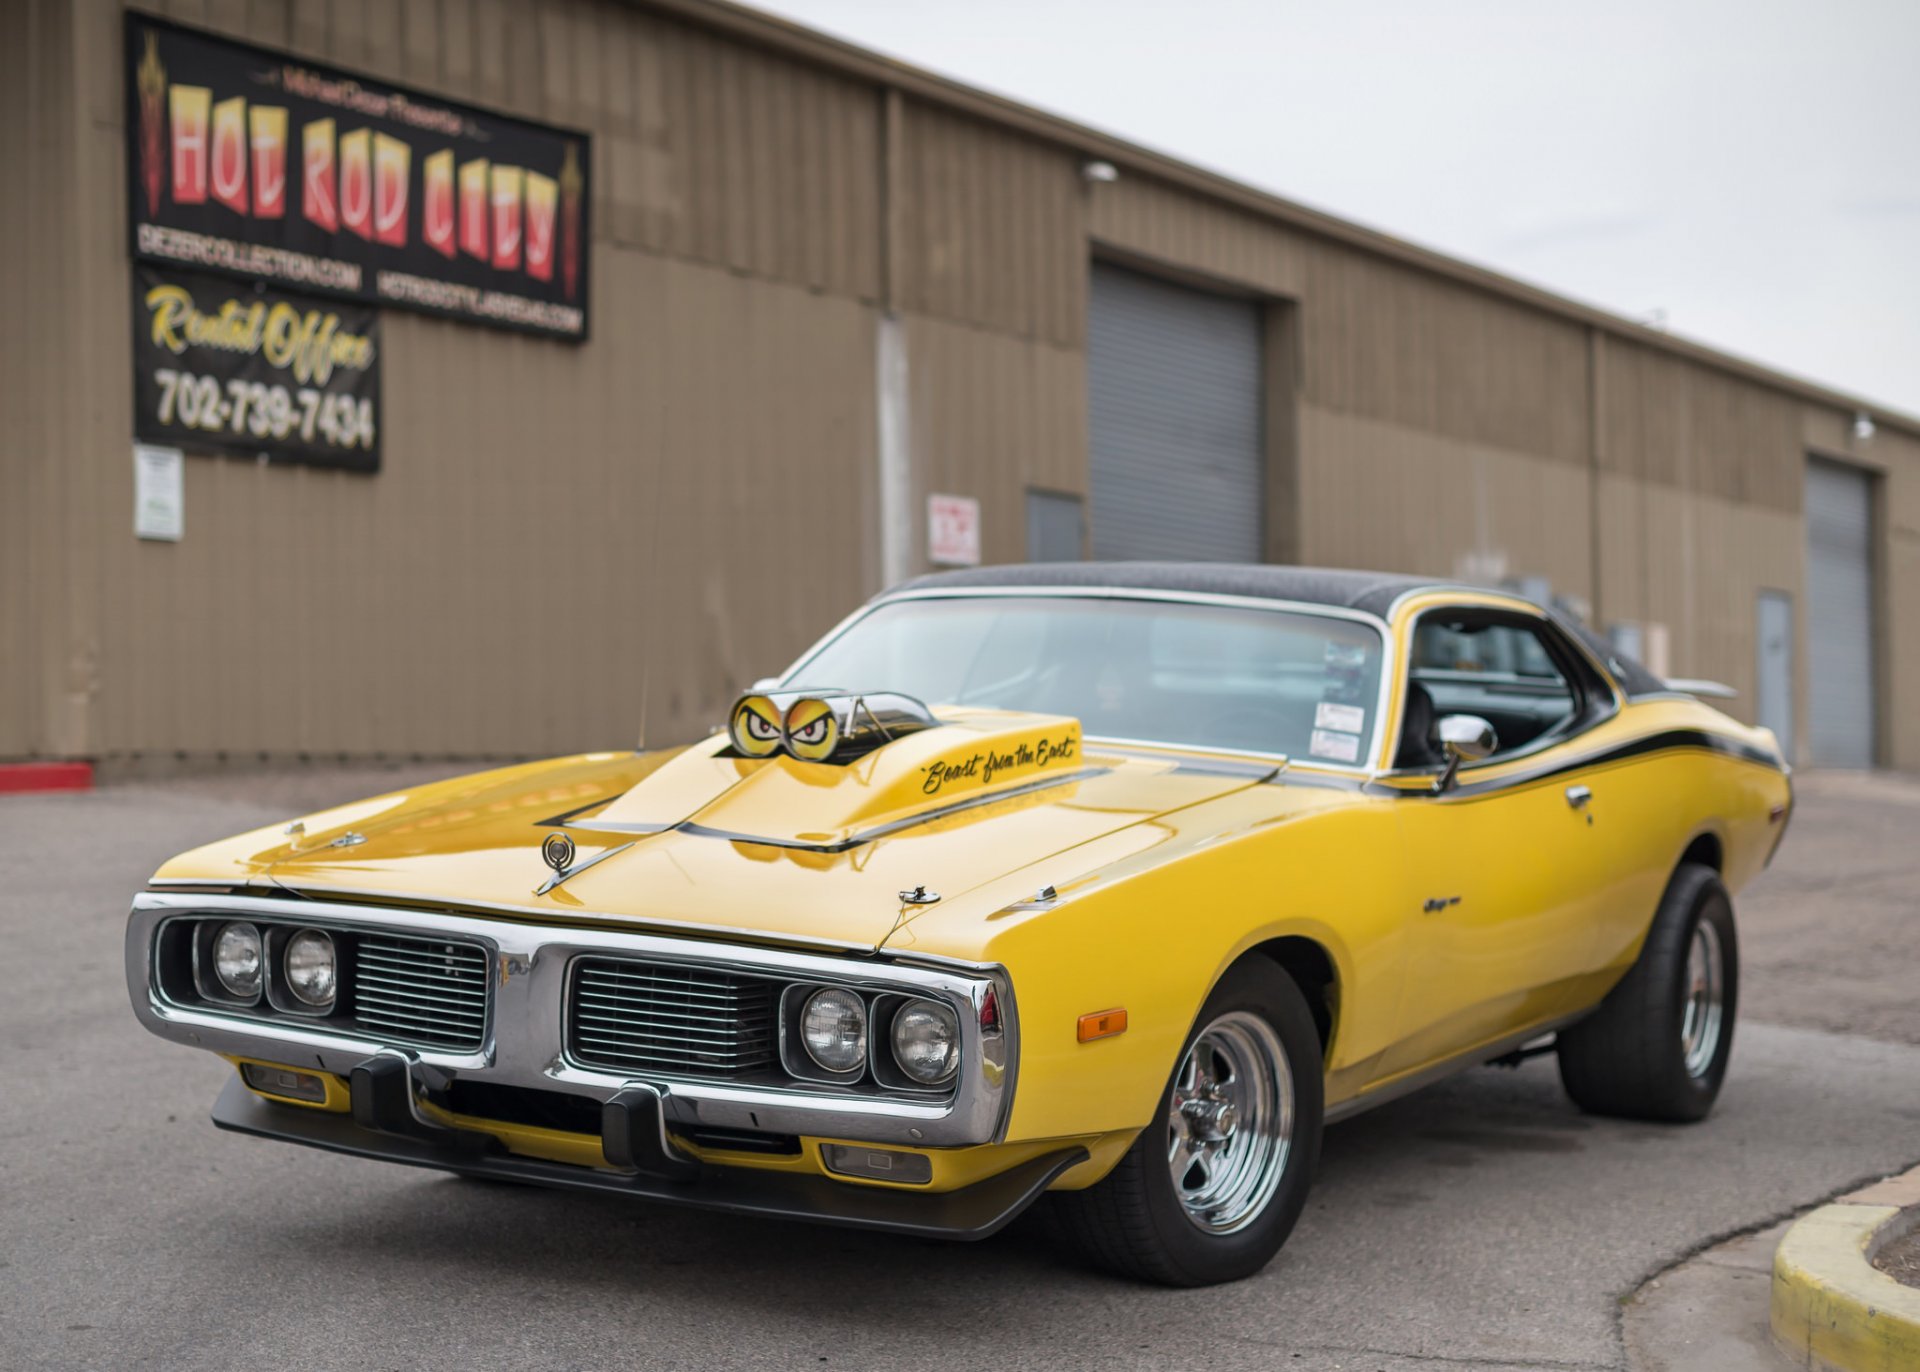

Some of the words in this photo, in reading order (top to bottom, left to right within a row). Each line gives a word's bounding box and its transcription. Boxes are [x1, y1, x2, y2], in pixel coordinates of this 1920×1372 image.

[169, 83, 289, 220] HOT
[303, 117, 412, 249] ROD
[422, 147, 560, 283] CITY
[137, 222, 362, 293] DEZERCOLLECTION.COM
[145, 284, 267, 355] Rental
[262, 301, 375, 387] Office
[154, 367, 375, 450] 702-739-7434
[983, 750, 1014, 784] from
[1014, 743, 1034, 768] the
[1036, 735, 1077, 768] East
